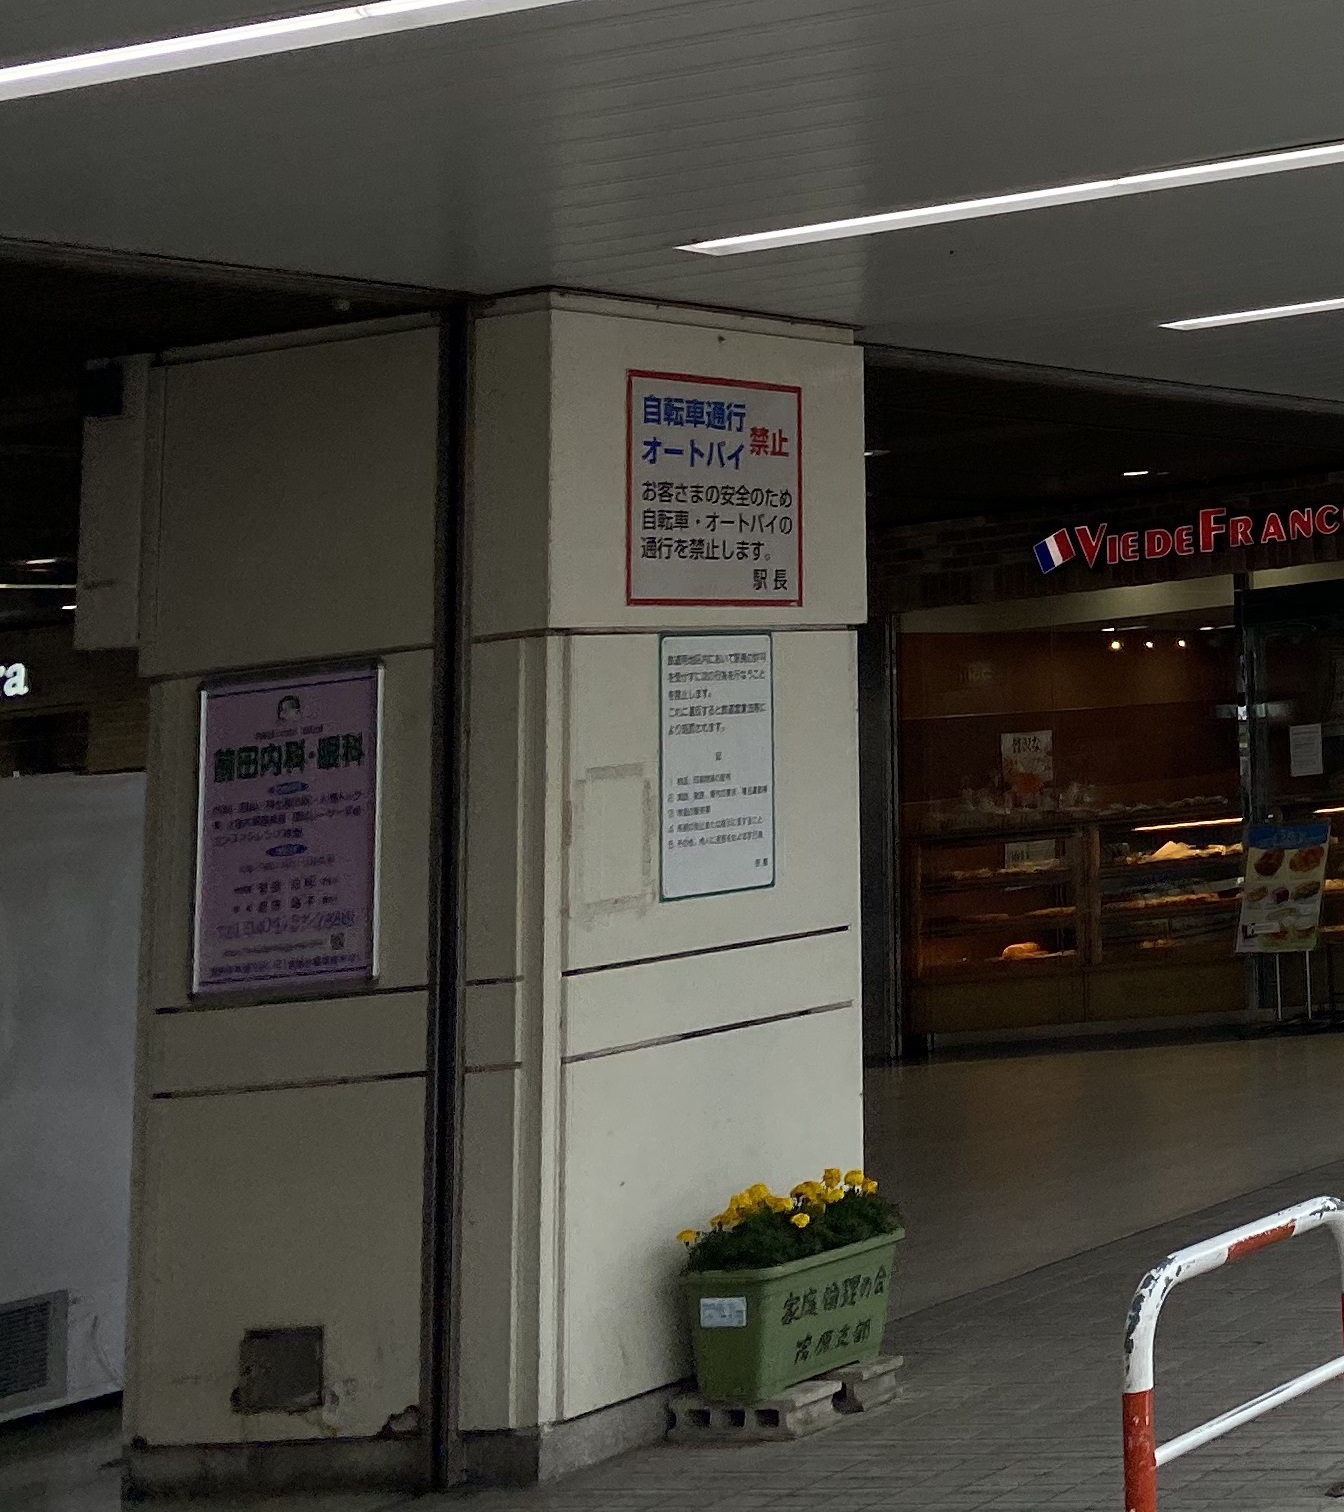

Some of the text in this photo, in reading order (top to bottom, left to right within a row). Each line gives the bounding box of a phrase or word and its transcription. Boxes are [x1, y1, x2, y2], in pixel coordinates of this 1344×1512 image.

[643, 394, 746, 432] 自転車通行
[641, 437, 745, 470] オートバイ
[750, 426, 789, 457] 禁止
[641, 480, 793, 509] お客さまの安全のため
[641, 507, 793, 535] 自転車・オートバイの
[641, 536, 771, 562] 通行を禁止します。
